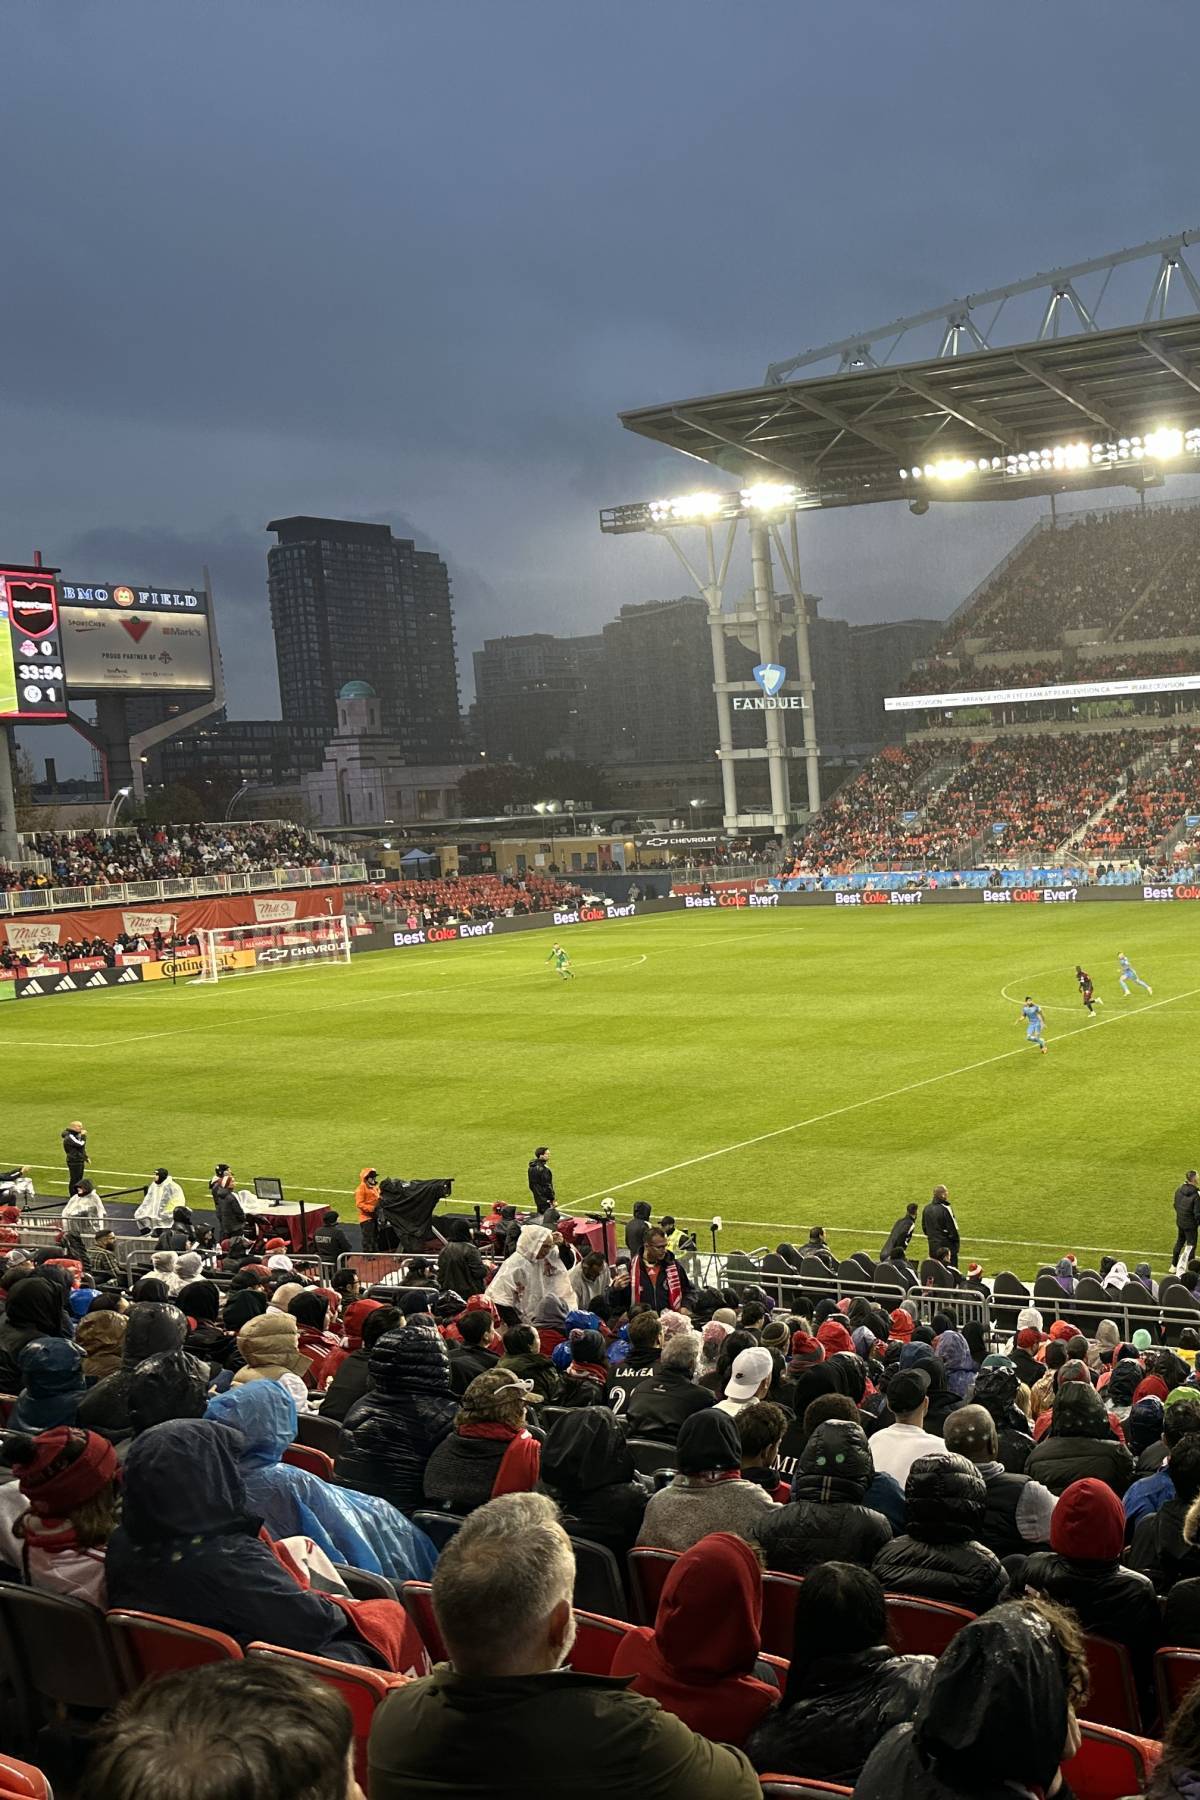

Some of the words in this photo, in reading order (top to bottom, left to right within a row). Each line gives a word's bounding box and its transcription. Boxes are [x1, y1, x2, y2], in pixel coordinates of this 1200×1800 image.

[64, 586, 108, 601] BMO
[138, 592, 198, 608] FIELD
[40, 640, 52, 656] 0
[19, 664, 64, 681] 33:54
[46, 688, 56, 702] 1
[733, 697, 809, 710] FANDUEL
[670, 836, 717, 844] CHEVROLET
[836, 892, 860, 904] Best
[863, 892, 888, 904] Coke
[890, 891, 922, 904] Ever?
[984, 890, 1010, 902] Best
[1012, 888, 1040, 901] Coke
[1044, 888, 1078, 901] Ever?
[1144, 886, 1174, 898] Best
[686, 896, 716, 908] Best
[719, 894, 746, 907] Coke
[750, 894, 779, 907] Ever?
[257, 903, 277, 914] Mill
[554, 911, 580, 925] Best
[580, 908, 605, 922] Coke
[606, 904, 636, 918] Ever?
[128, 914, 150, 928] Mill
[11, 928, 38, 940] Mill
[394, 930, 426, 946] Best
[428, 926, 456, 942] Coke
[460, 922, 494, 938] Ever?
[162, 954, 228, 976] Contineal
[616, 1368, 654, 1378] LARYEA
